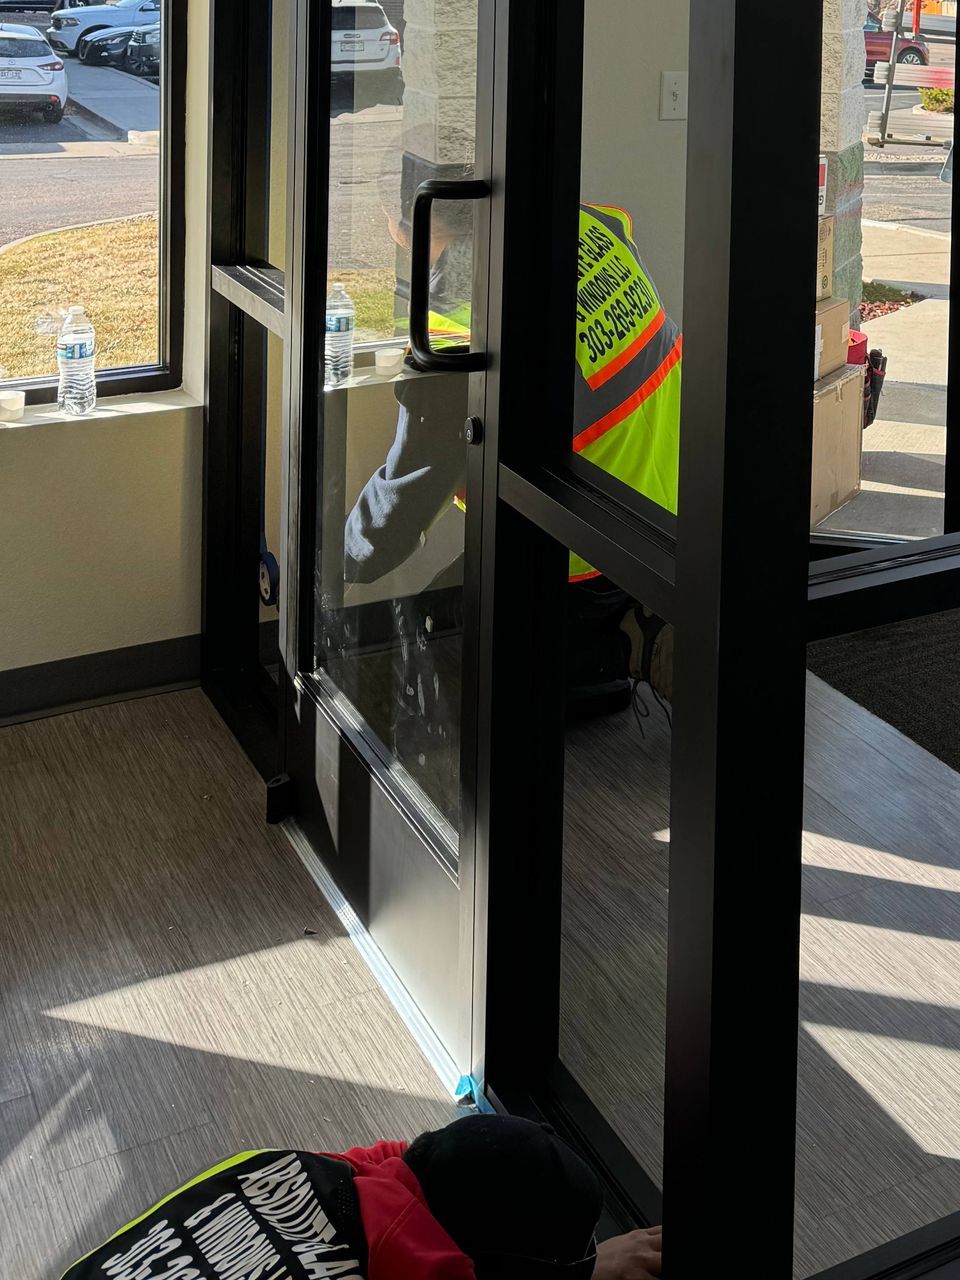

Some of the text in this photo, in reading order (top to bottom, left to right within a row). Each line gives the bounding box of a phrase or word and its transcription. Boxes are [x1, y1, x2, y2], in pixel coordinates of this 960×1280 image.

[577, 266, 621, 316] WINDOWS
[606, 254, 632, 283] LLC
[578, 274, 655, 363] 303-269-9230
[183, 1192, 236, 1229] &
[237, 1152, 336, 1243] ABSOLUTE
